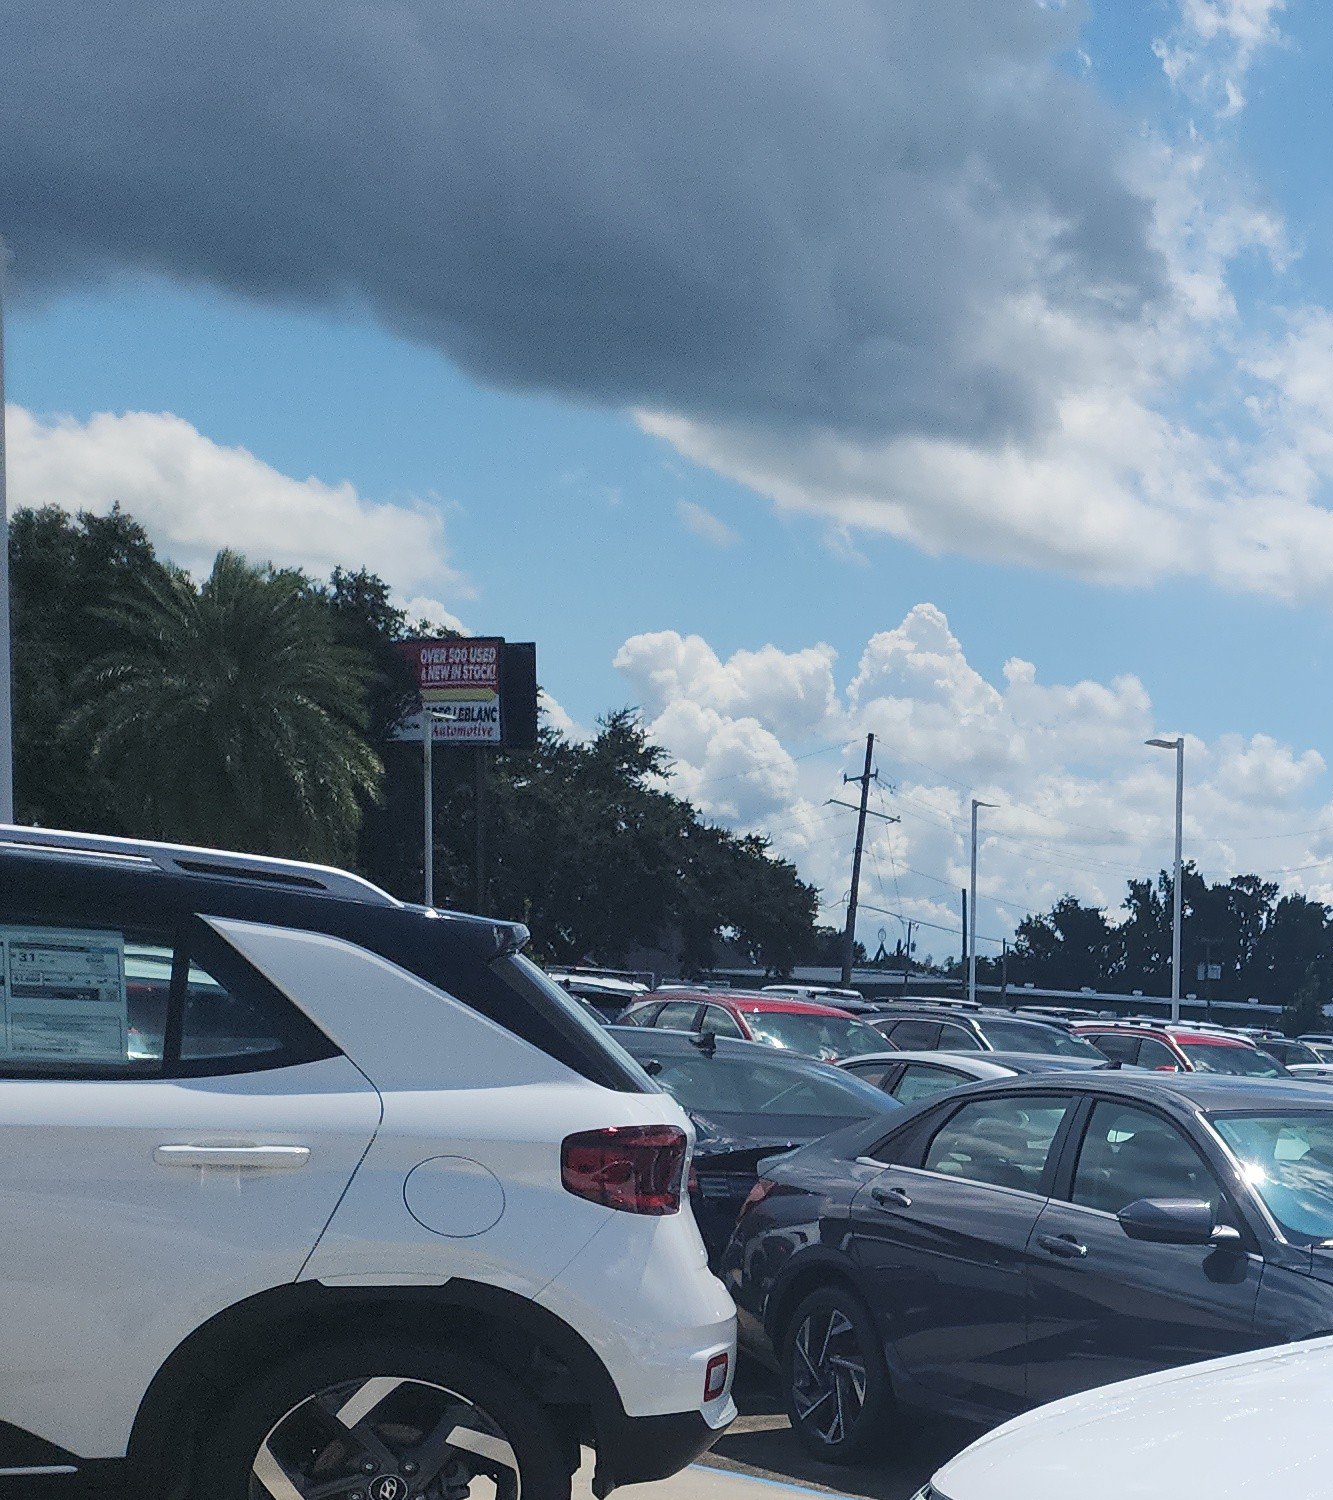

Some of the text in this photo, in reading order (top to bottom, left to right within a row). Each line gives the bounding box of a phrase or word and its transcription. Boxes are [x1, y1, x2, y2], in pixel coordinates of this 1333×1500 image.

[420, 648, 446, 664] OVER
[469, 647, 496, 663] USED
[427, 665, 450, 681] NEW
[451, 664, 462, 680] IN
[452, 706, 498, 723] LEBLANC
[432, 724, 494, 737] Automotive
